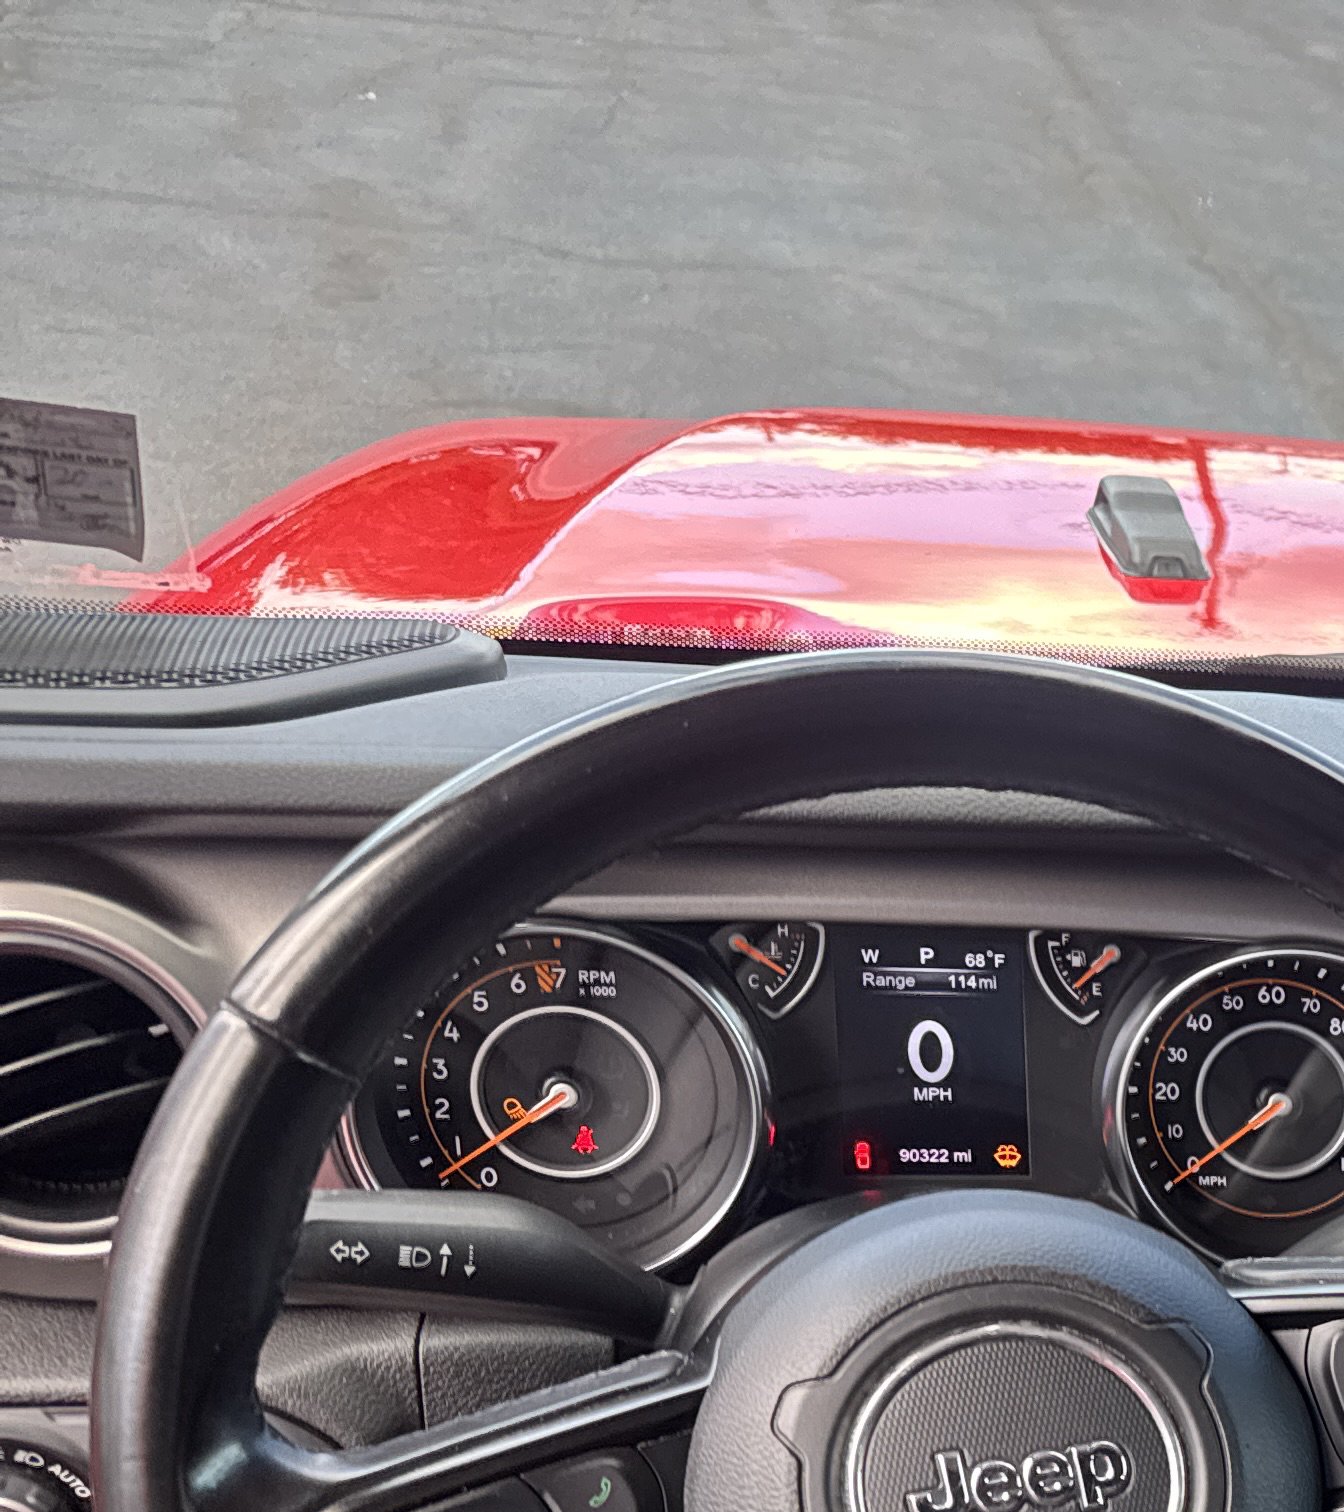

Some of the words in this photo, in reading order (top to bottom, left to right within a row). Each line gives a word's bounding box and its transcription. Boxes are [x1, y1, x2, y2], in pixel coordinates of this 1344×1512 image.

[777, 923, 789, 937] H
[1061, 932, 1071, 947] F
[861, 948, 880, 964] W
[919, 947, 934, 965] P
[510, 973, 526, 994] 6
[551, 968, 567, 989] 7
[578, 969, 616, 984] RPM
[748, 973, 760, 989] C
[862, 971, 916, 991] Range
[589, 986, 616, 997] 1000
[1091, 981, 1102, 997] E
[1257, 985, 1286, 1005] 60
[473, 991, 489, 1012] 5
[1221, 994, 1244, 1012] 50
[1300, 997, 1322, 1014] 70
[1186, 1013, 1213, 1032] 40
[444, 1021, 460, 1043] 4
[907, 1019, 954, 1084] 0
[1166, 1047, 1188, 1064] 30
[432, 1058, 448, 1080] 3
[913, 1087, 953, 1102] MPH
[1154, 1081, 1181, 1102] 20
[434, 1098, 451, 1120] 2
[1167, 1124, 1183, 1141] 10
[899, 1148, 949, 1163] 90322
[953, 1148, 972, 1163] mi
[1186, 1155, 1201, 1174] 0
[480, 1166, 498, 1187] 0
[1198, 1174, 1227, 1188] MPH
[47, 1463, 91, 1498] AUTO
